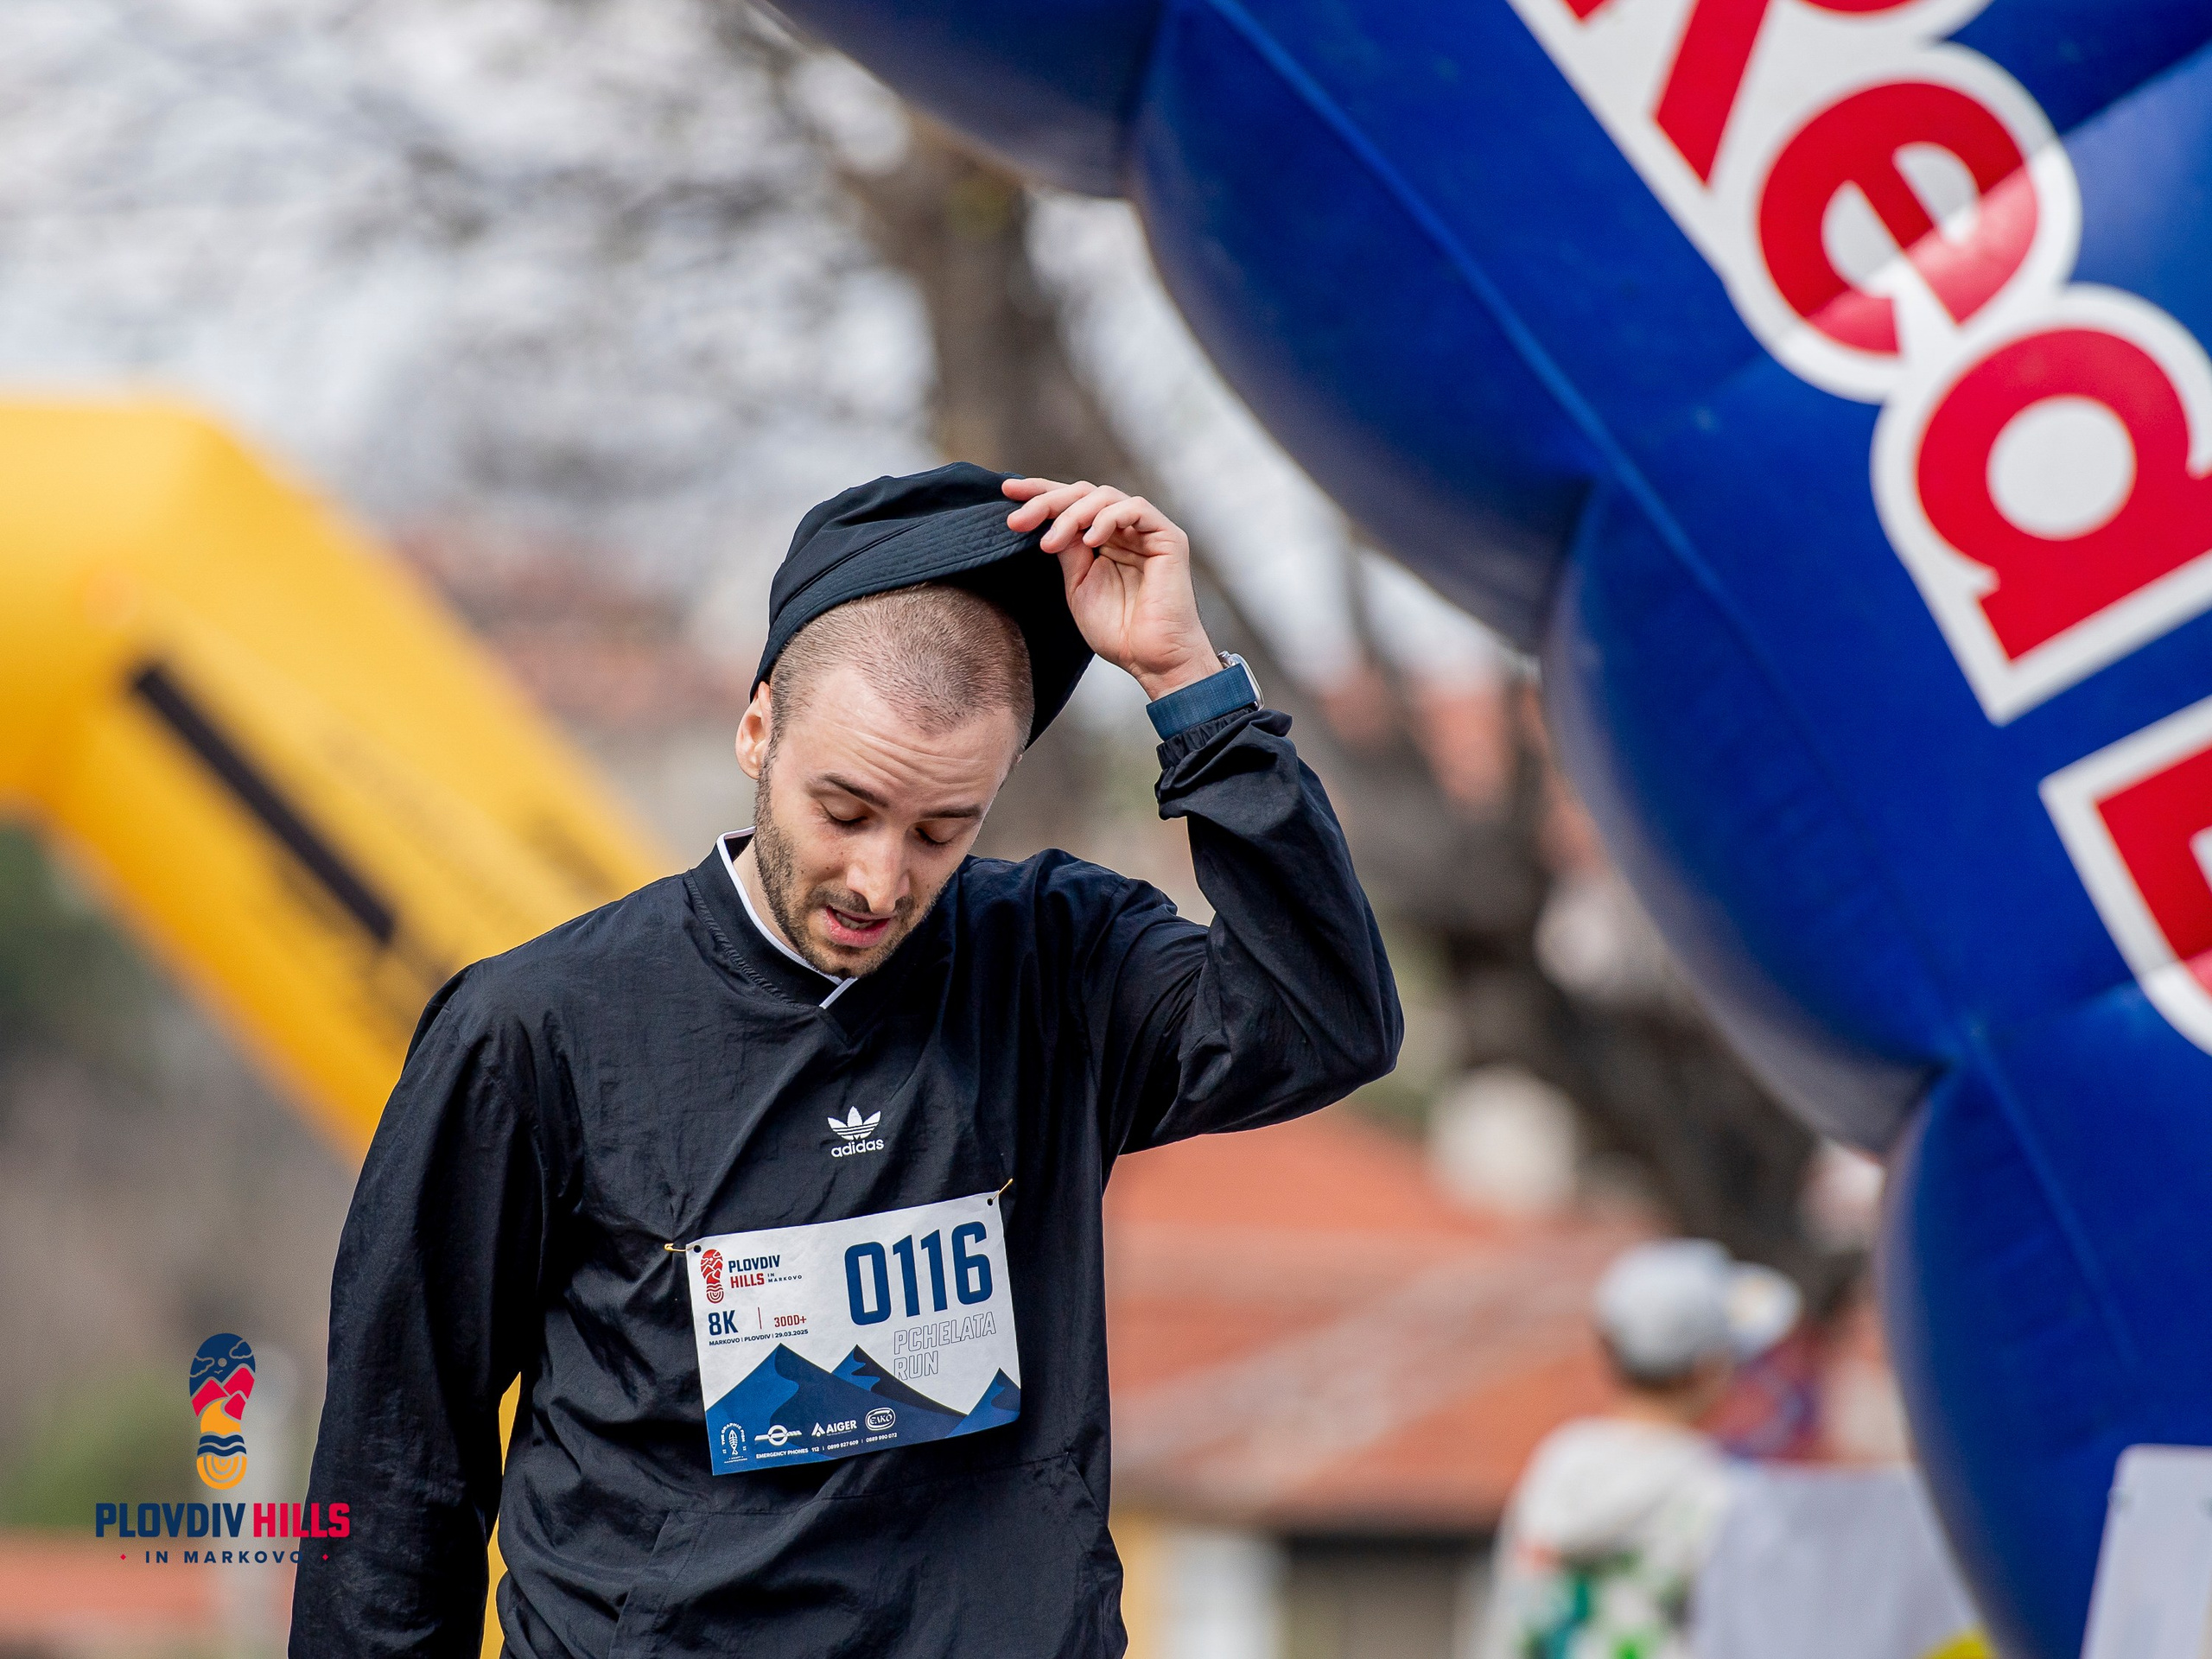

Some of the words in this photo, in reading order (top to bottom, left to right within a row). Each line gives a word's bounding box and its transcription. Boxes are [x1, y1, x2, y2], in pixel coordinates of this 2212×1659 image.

[831, 1139, 884, 1157] adidas
[728, 1255, 780, 1273] PLOVDIV
[730, 1273, 765, 1288] HILLS
[768, 1274, 802, 1283] MARKOVO
[844, 1221, 993, 1325] 0116
[708, 1310, 739, 1336] 8K
[773, 1314, 807, 1328] 300D+
[709, 1338, 741, 1346] MARKOVO
[744, 1333, 771, 1342] PLOVDIV
[775, 1329, 809, 1338] 29.03.2025
[893, 1312, 996, 1355] PCHELATA
[894, 1351, 939, 1381] RUN
[826, 1420, 857, 1434] AIGER
[756, 1451, 787, 1459] EMERGENCY
